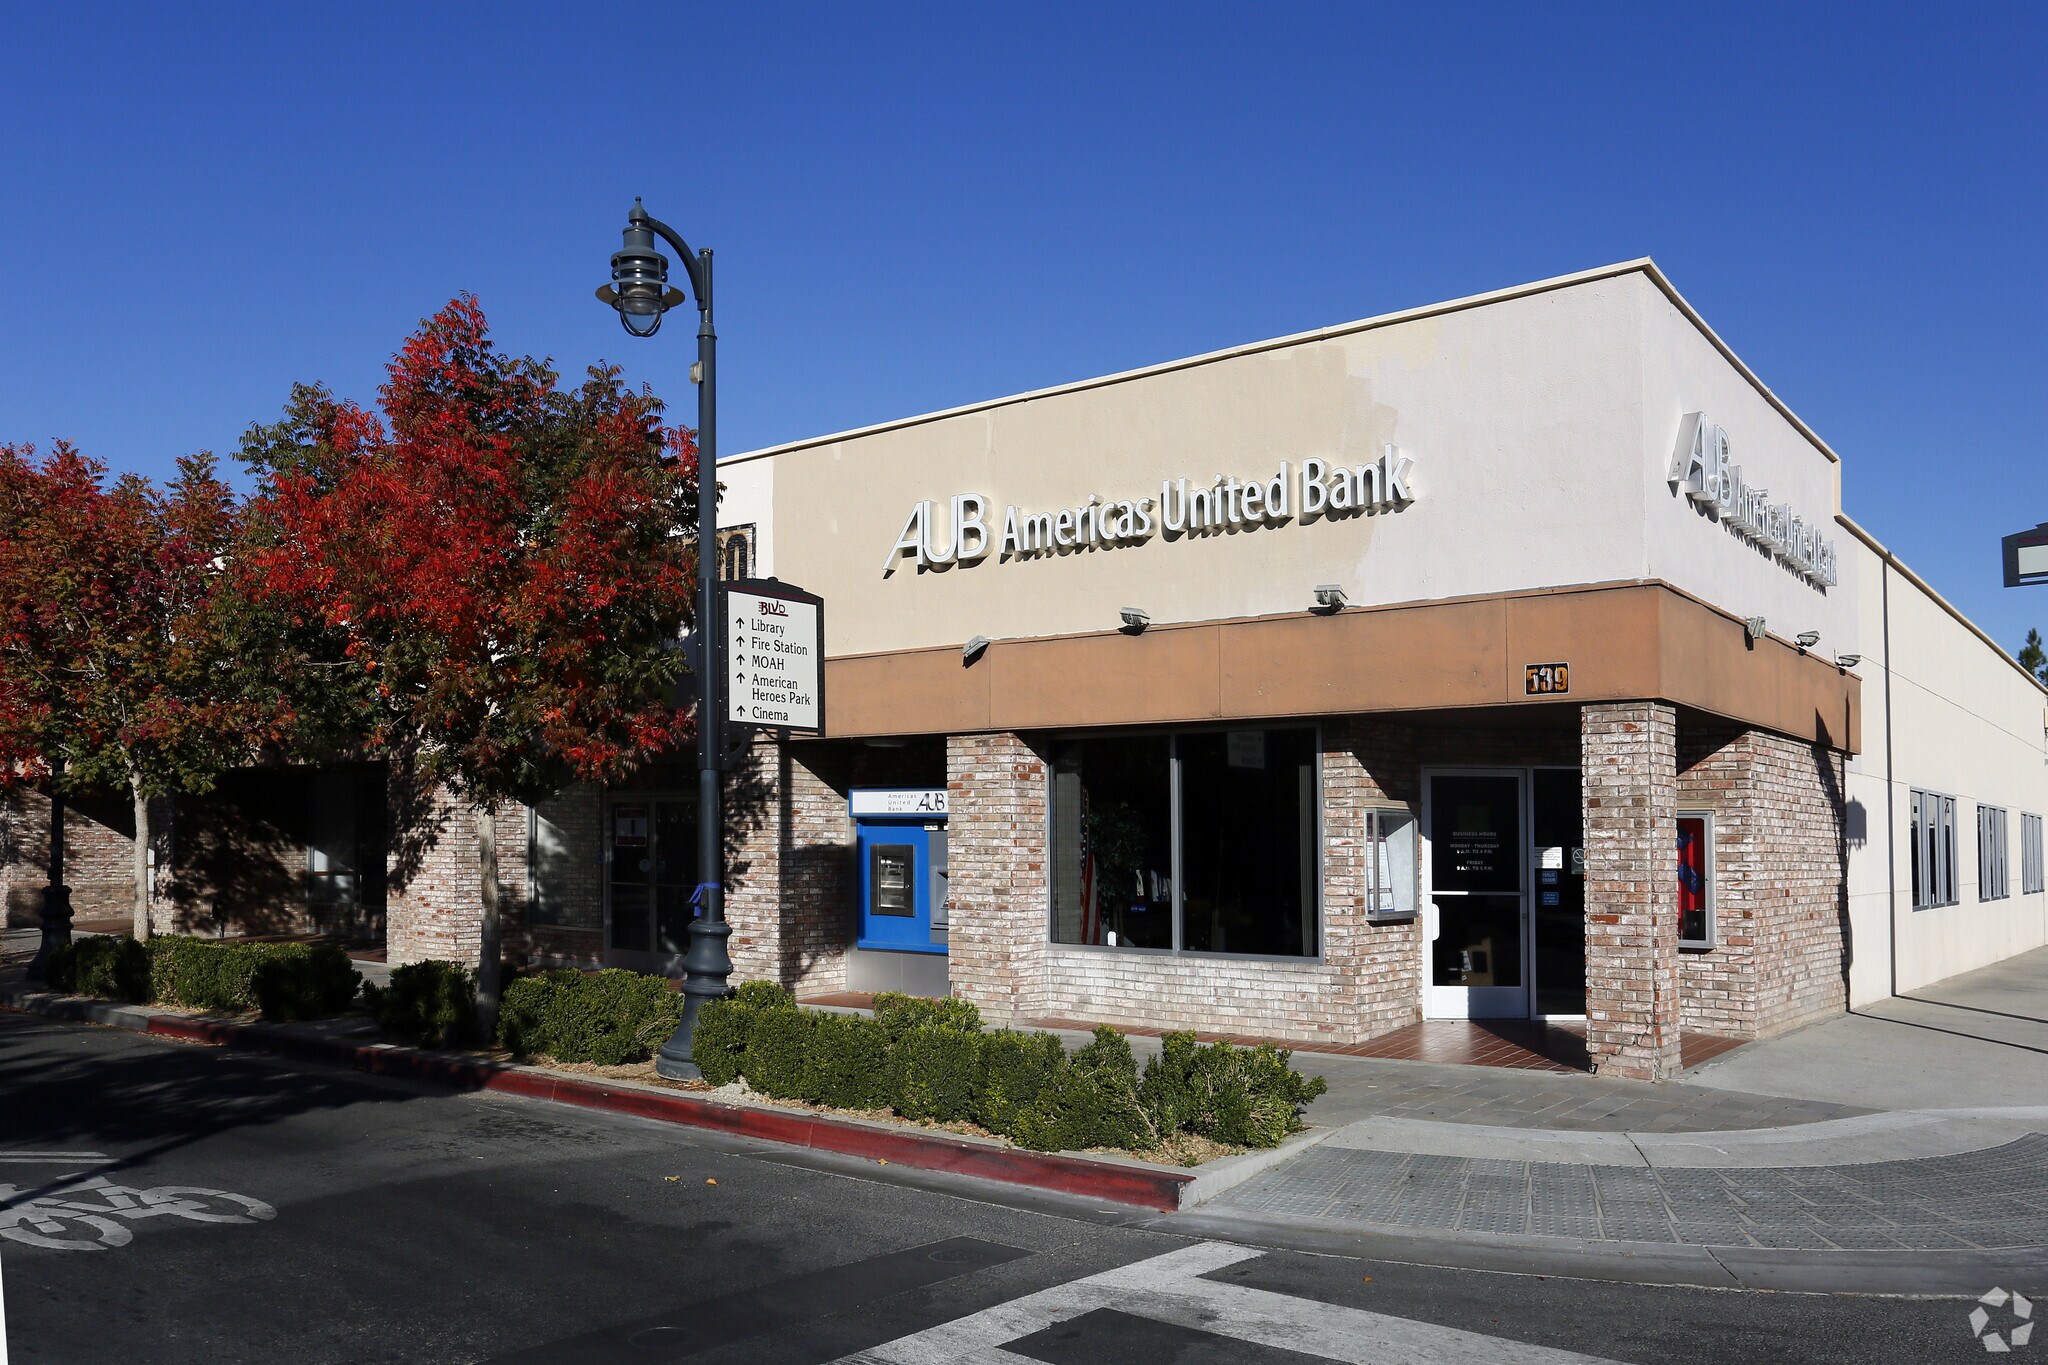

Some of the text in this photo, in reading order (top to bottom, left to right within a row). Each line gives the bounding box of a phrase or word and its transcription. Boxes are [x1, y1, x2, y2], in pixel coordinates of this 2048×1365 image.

[882, 443, 1412, 573] AUB Americas United Bank
[758, 600, 789, 617] BLVD
[751, 618, 785, 637] Library
[751, 636, 808, 656] Fire Station
[751, 655, 785, 670] MOAH
[751, 673, 798, 690] American
[752, 688, 811, 706] Heroes Park
[752, 706, 789, 721] Cinema
[915, 792, 945, 811] AUB
